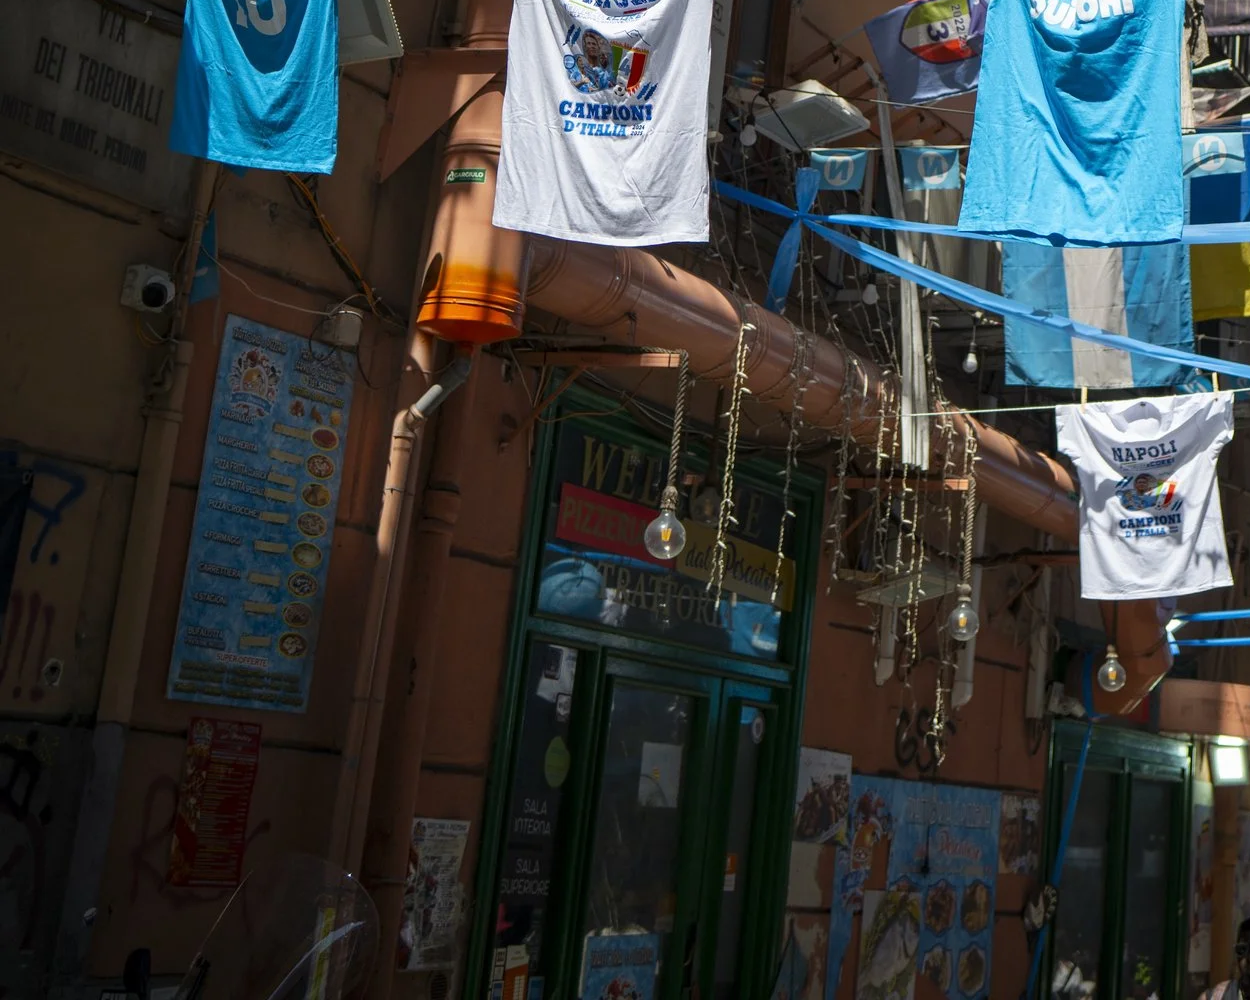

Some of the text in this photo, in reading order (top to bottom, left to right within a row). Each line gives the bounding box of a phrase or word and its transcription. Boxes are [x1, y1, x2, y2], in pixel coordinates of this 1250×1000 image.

[99, 8, 126, 44] VIA
[927, 22, 950, 42] 3
[34, 37, 164, 125] DEI TRIBUNALI
[560, 101, 652, 121] CAMPIONI
[564, 120, 628, 137] D'ITALIA
[1112, 440, 1178, 463] NAPOLI
[1120, 513, 1182, 529] CAMPIONI
[1125, 526, 1168, 538] D'ITALIA
[524, 798, 548, 815] SALA
[513, 818, 551, 835] INTERNA
[516, 858, 541, 874] SALA
[499, 878, 551, 896] SUPERIORE
